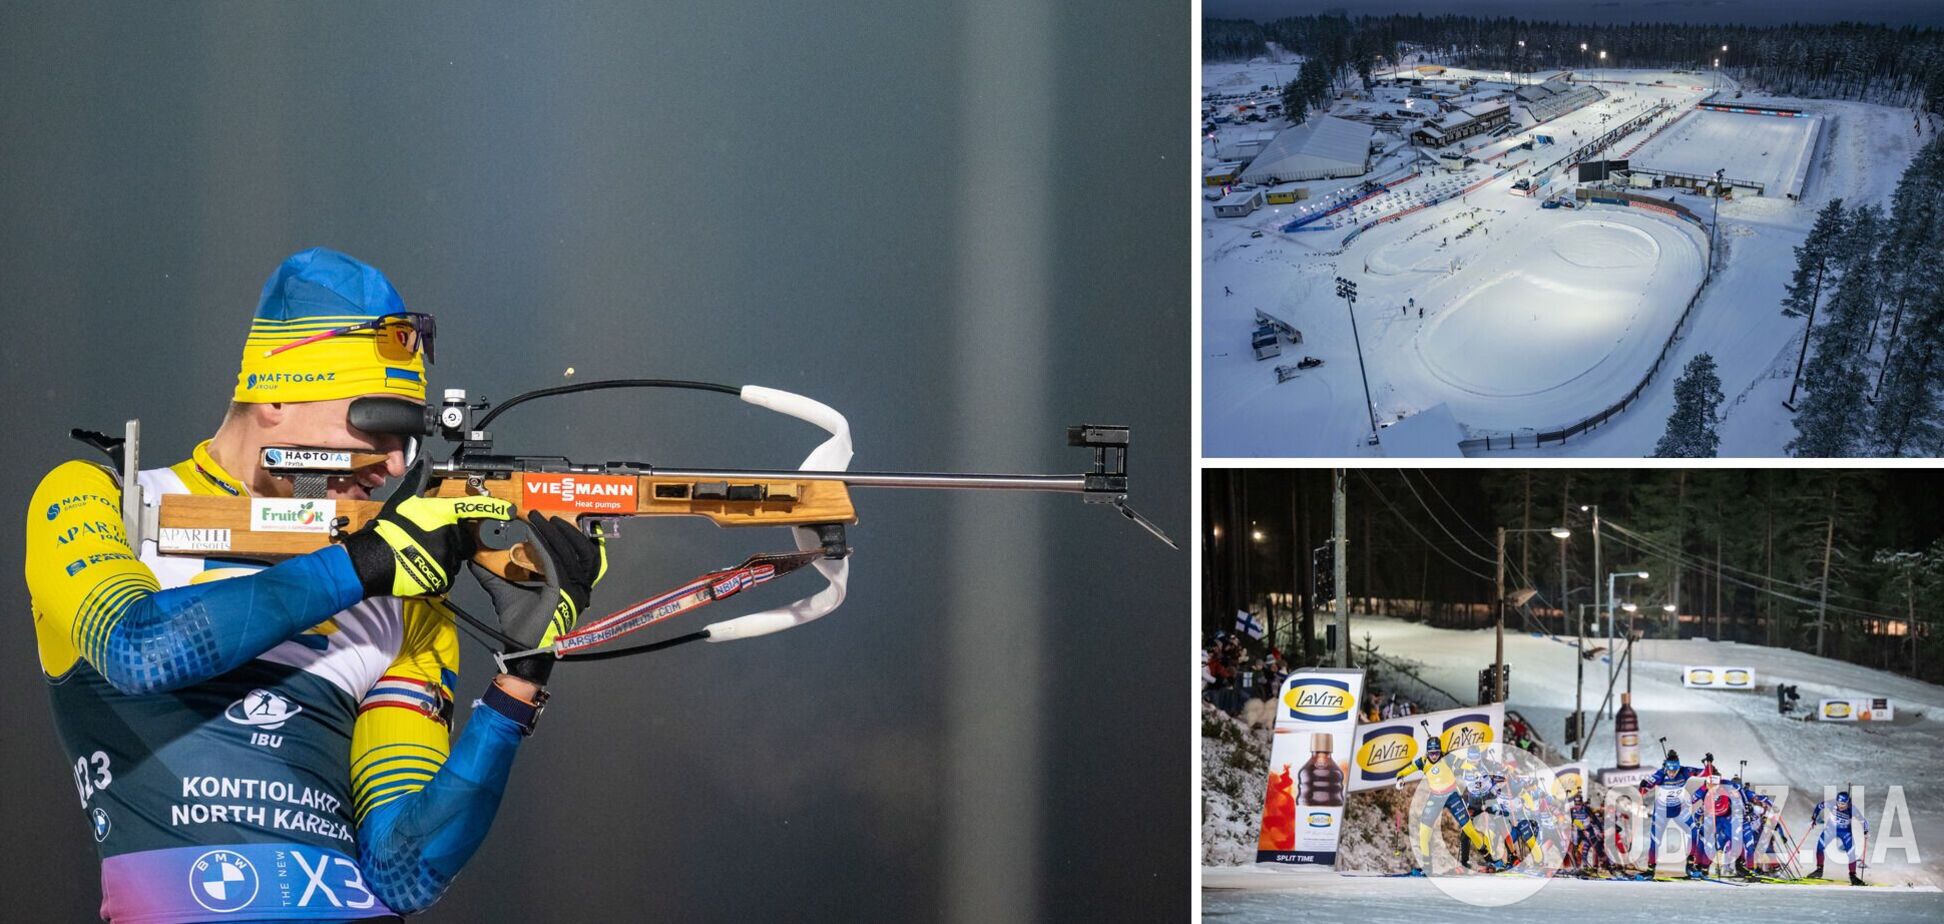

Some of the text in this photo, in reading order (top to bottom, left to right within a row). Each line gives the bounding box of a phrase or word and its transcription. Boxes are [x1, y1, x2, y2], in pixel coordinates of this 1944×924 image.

[259, 373, 335, 382] NAFTOGAZ
[527, 477, 634, 502] VIESSMANN
[575, 500, 621, 509] Heat pumps
[250, 732, 283, 748] IBU
[182, 776, 341, 815] KONTIOLAHTI
[171, 804, 354, 843] NORTH KARELIA
[197, 852, 248, 872] BMW
[1276, 854, 1296, 862] SPLIT
[276, 850, 291, 907] THE NEW
[289, 850, 375, 909] X3
